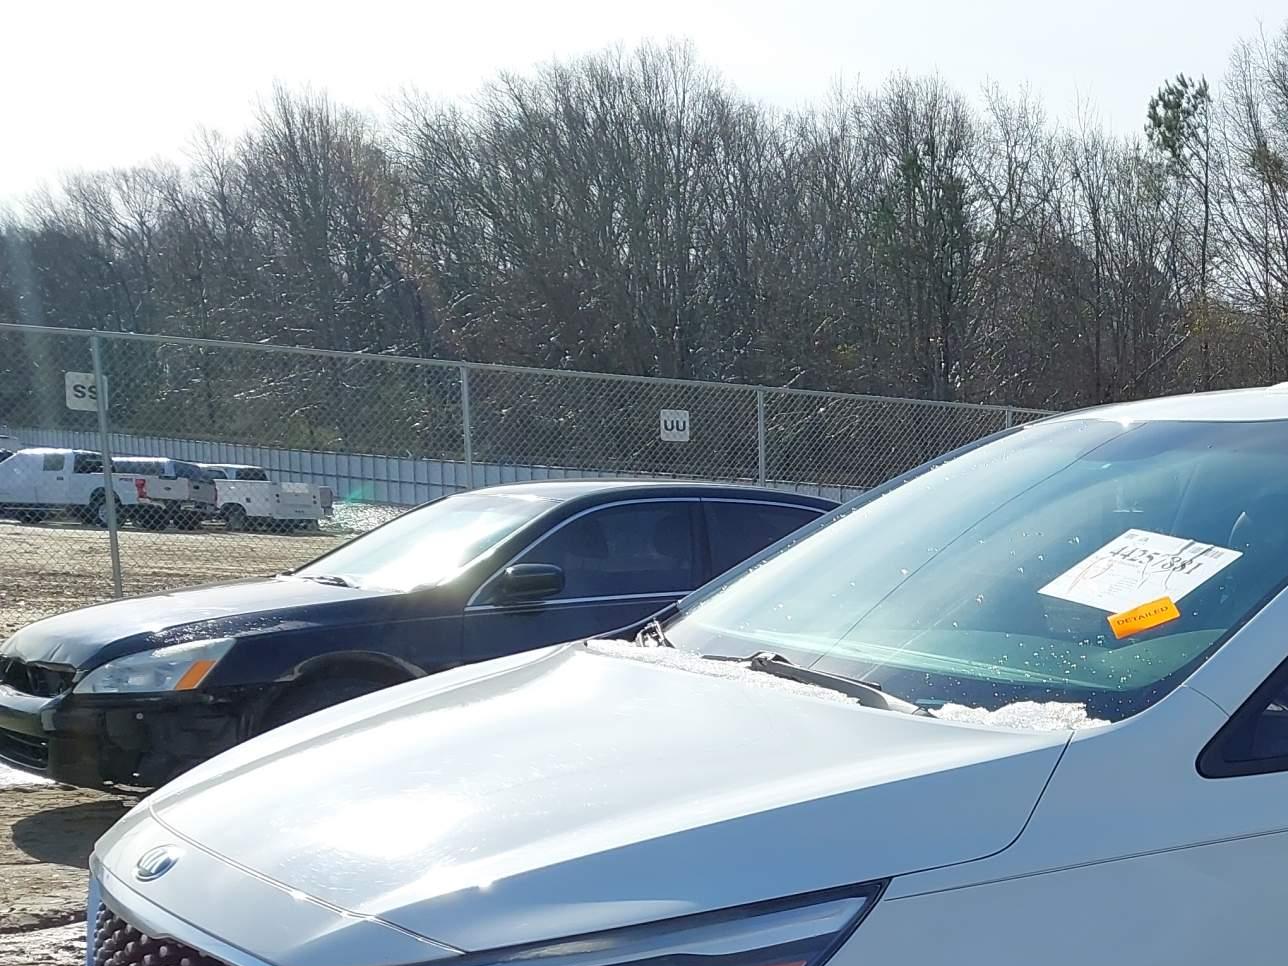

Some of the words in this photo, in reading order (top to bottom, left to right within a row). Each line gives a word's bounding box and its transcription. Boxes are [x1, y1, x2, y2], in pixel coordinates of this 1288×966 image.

[72, 383, 97, 400] SS
[663, 418, 687, 432] UU
[1116, 605, 1169, 626] DETAILED
